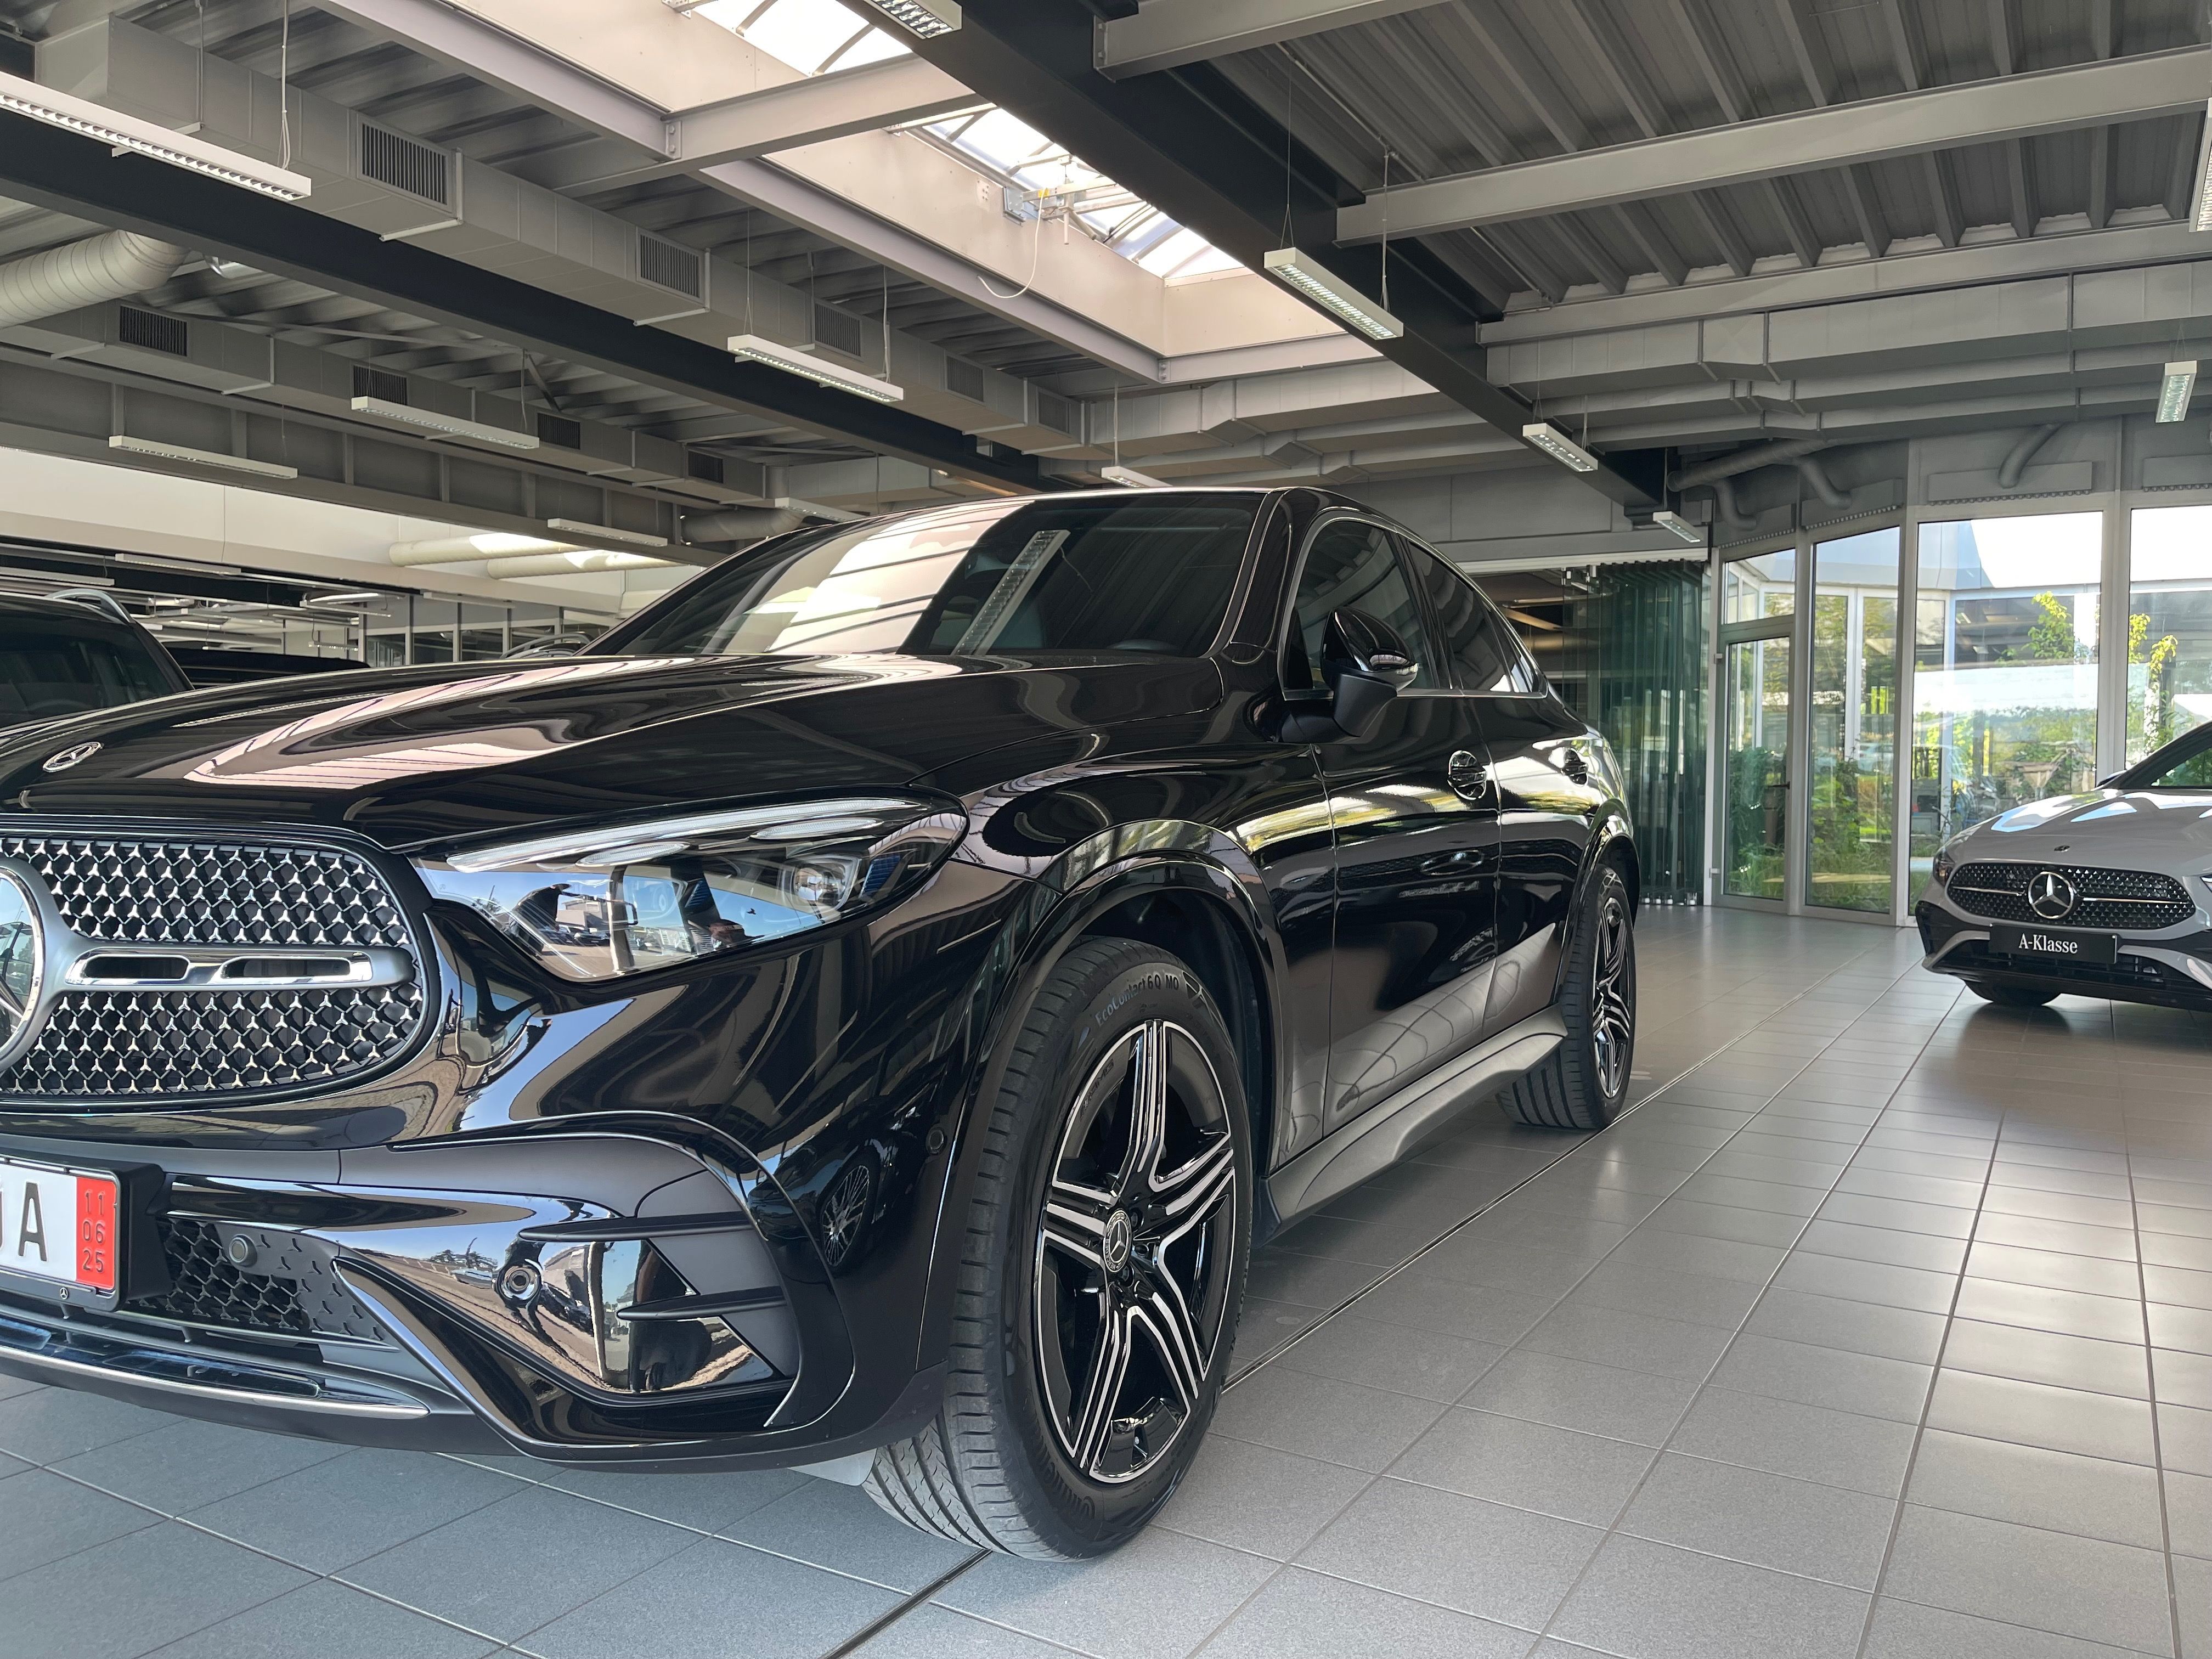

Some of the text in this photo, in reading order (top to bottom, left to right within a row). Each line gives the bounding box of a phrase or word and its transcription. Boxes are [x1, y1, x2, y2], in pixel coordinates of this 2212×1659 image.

[2018, 933, 2078, 954] A-Klasse
[1165, 974, 1179, 990] MO
[85, 1191, 104, 1215] 11
[83, 1220, 105, 1244] 06
[83, 1249, 104, 1273] 25
[1229, 1333, 1237, 1353] XL
